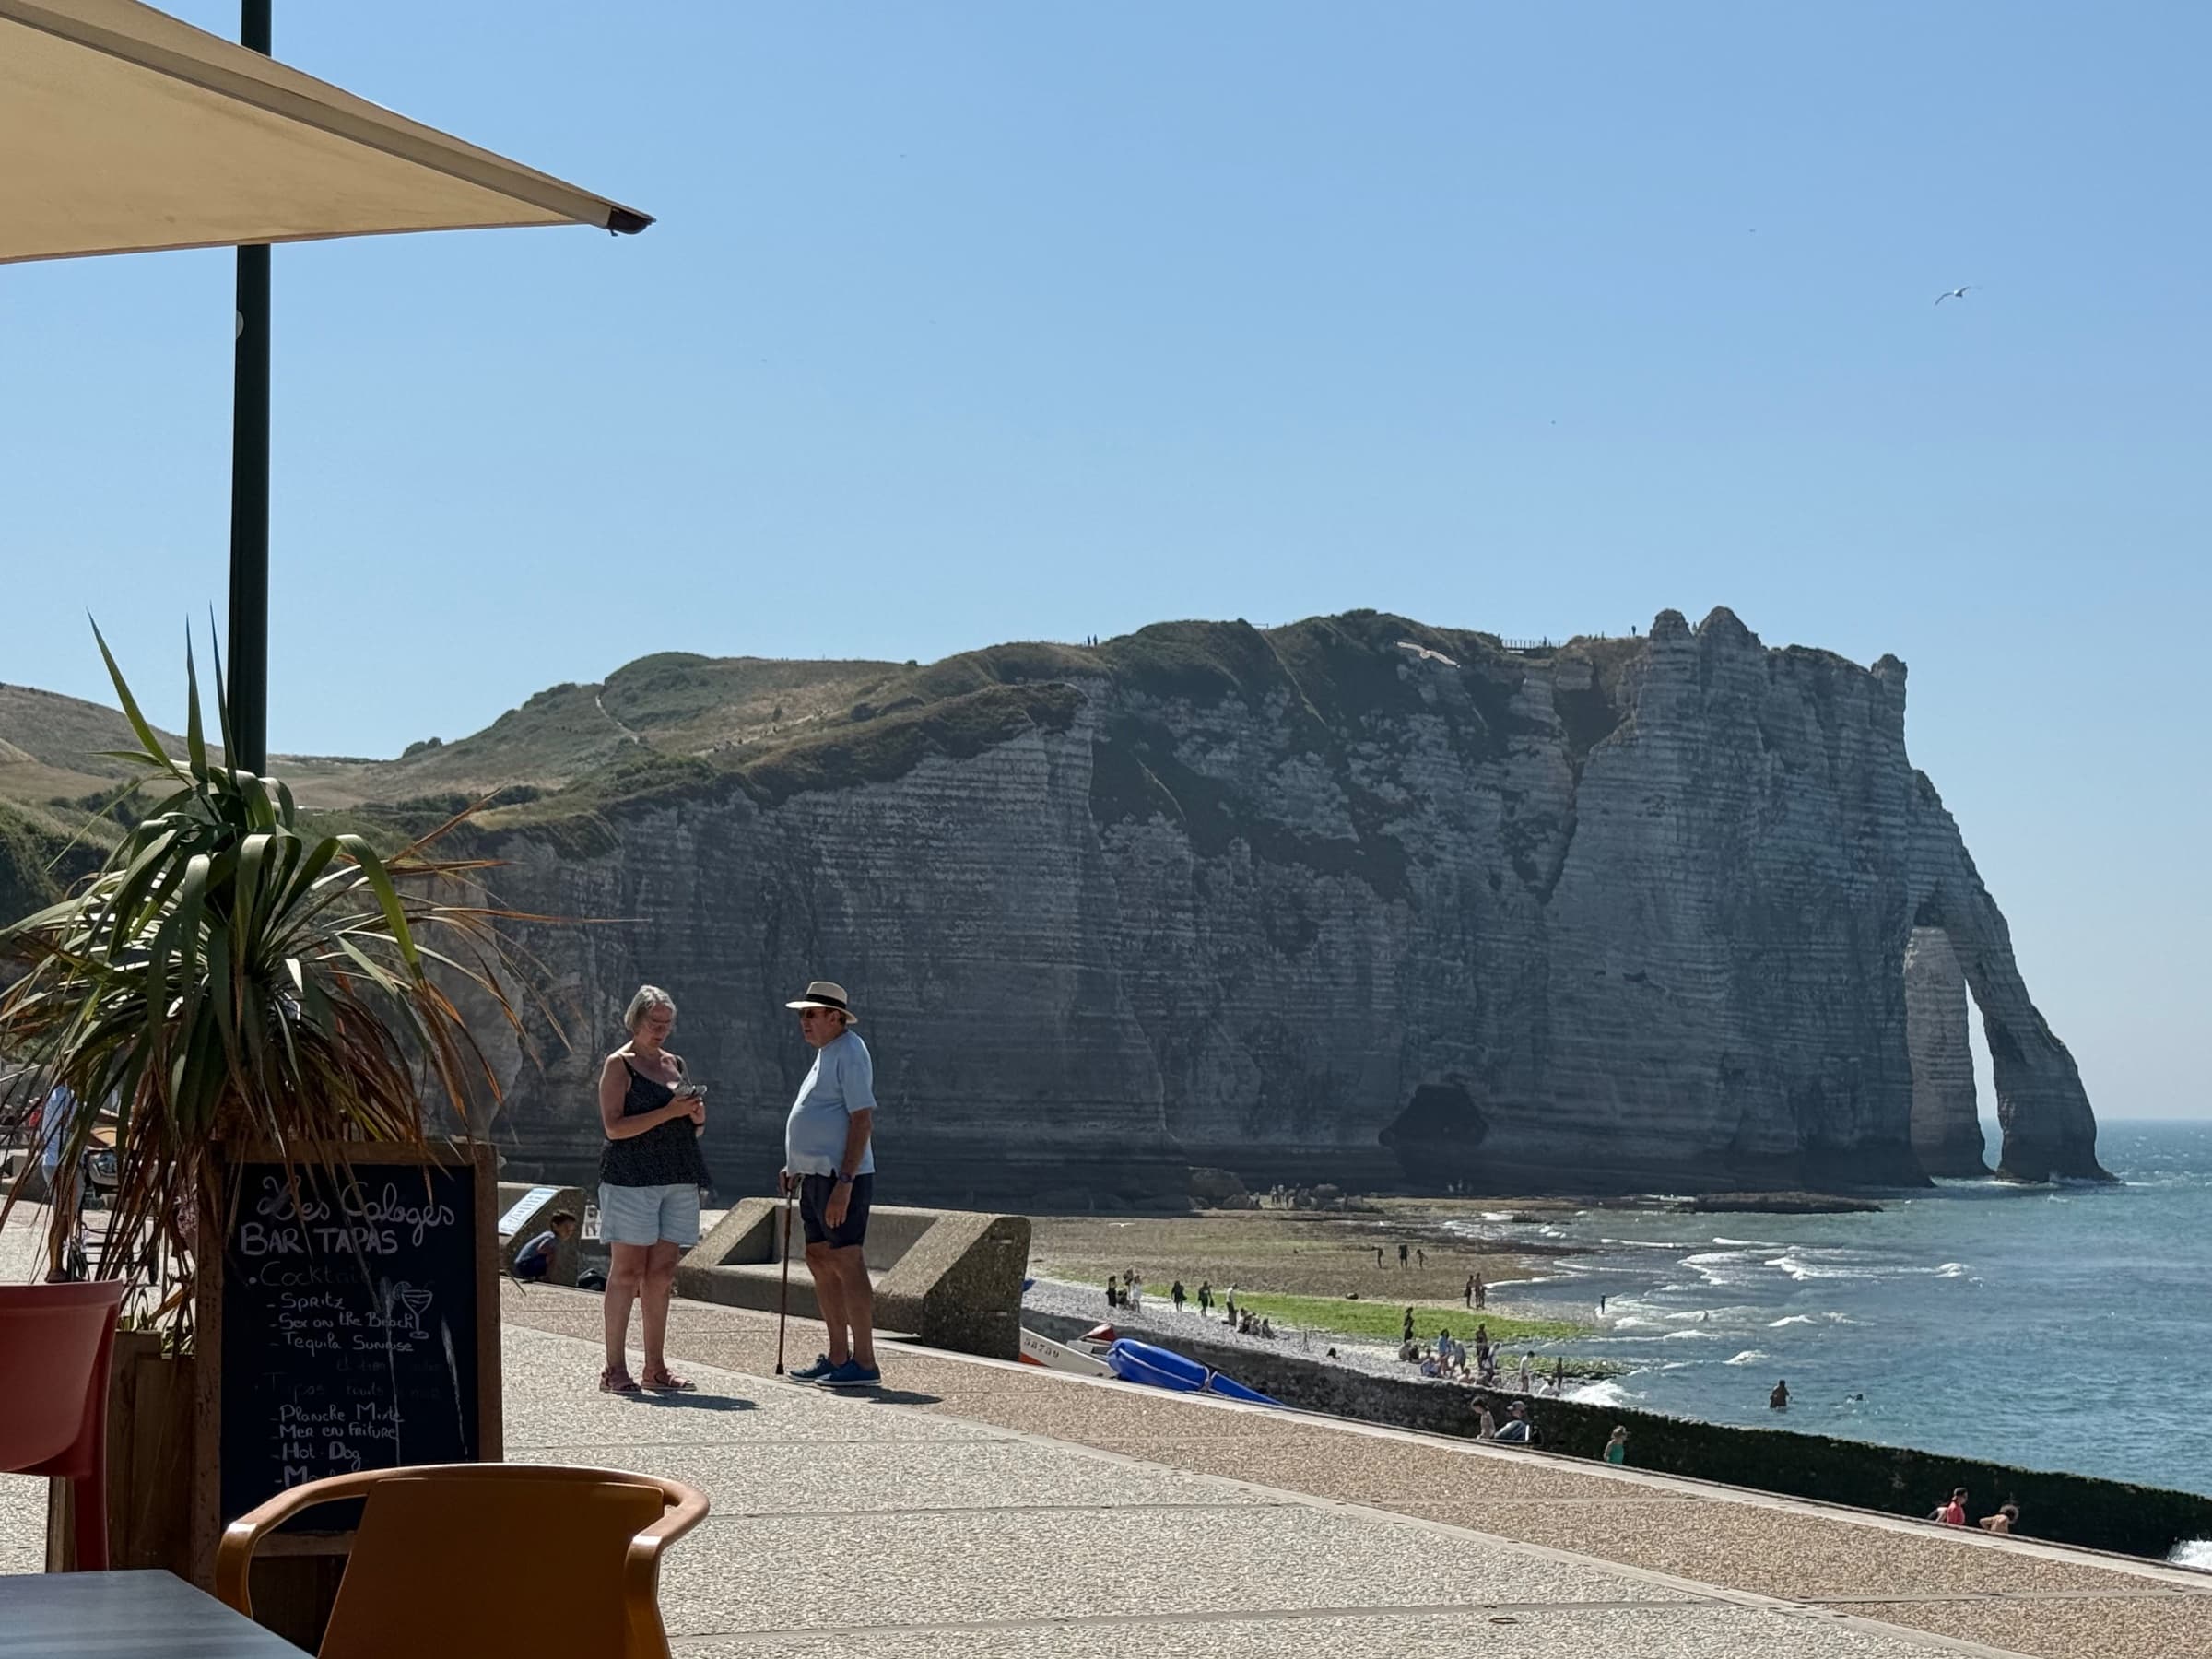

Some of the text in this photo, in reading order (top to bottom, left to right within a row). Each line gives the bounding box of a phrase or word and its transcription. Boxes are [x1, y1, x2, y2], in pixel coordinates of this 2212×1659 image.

[342, 1181, 456, 1247] Caloges
[312, 1227, 399, 1255] TAPAS
[339, 1311, 363, 1327] the
[280, 1331, 341, 1357] Tequila
[279, 1403, 346, 1422] Planche
